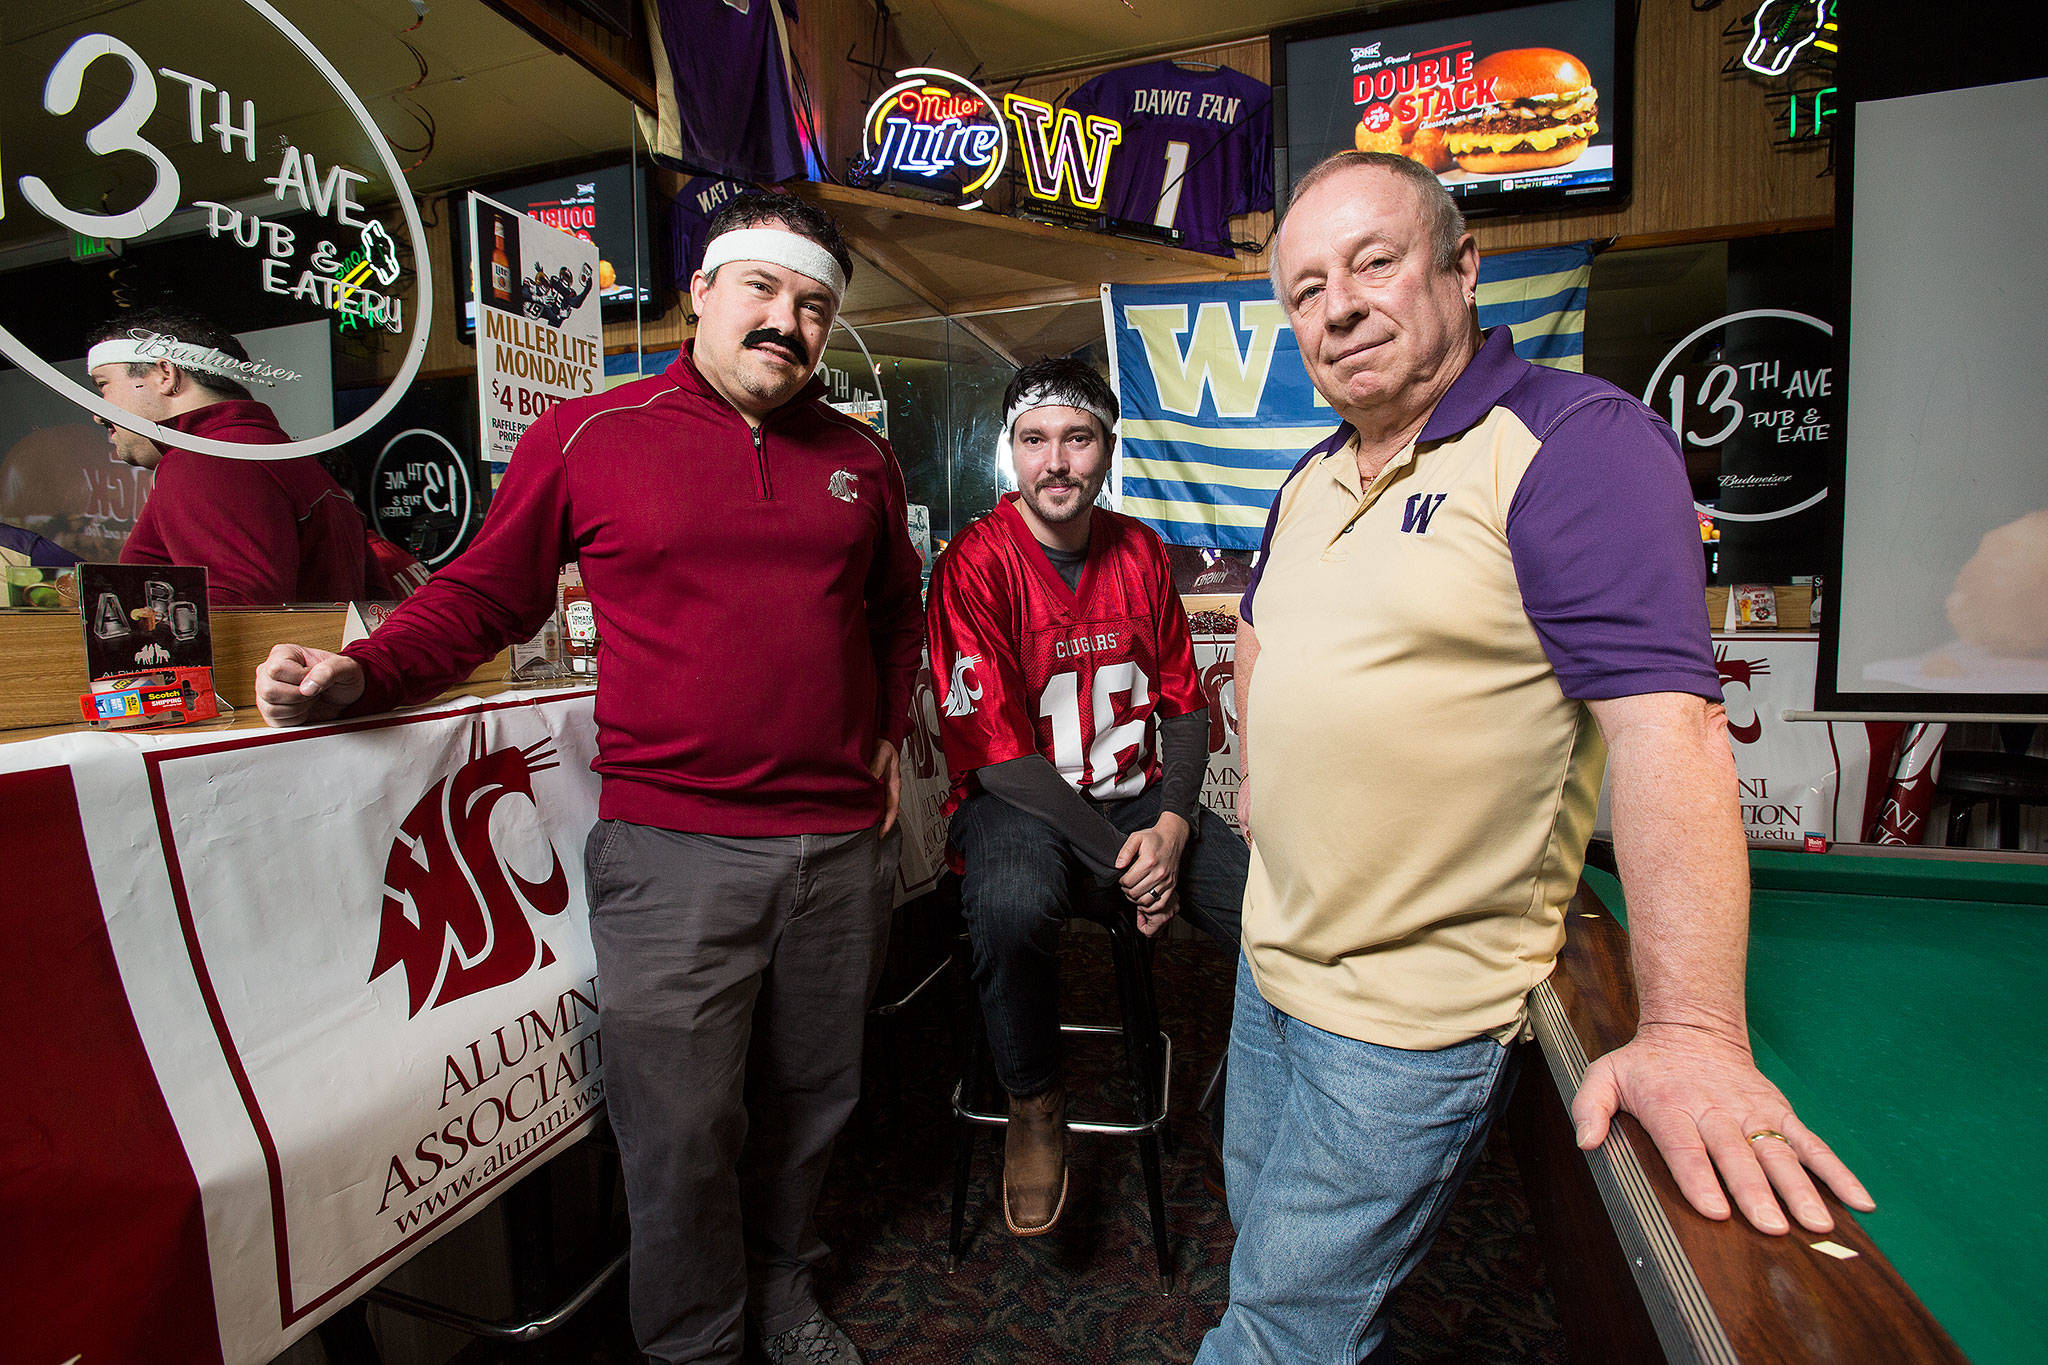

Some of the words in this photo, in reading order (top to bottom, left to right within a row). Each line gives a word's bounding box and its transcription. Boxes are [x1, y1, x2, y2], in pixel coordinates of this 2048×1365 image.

[1353, 61, 1382, 74] Quarter
[1384, 53, 1411, 65] Pound
[1353, 51, 1474, 105] DOUBLE
[900, 92, 985, 122] Miller
[1134, 88, 1192, 116] DAWG
[1197, 94, 1242, 124] FAN
[1399, 77, 1499, 124] STACK
[1468, 109, 1483, 120] and
[1485, 106, 1500, 117] Tots
[0, 33, 257, 239] 3TH
[264, 146, 368, 228] AVE
[873, 117, 1000, 177] Lite
[1004, 93, 1122, 210] W
[1153, 141, 1190, 229] 1
[192, 201, 296, 258] PUB
[311, 241, 344, 273] &
[262, 258, 402, 333] EATERY
[127, 328, 302, 382] Budweiser
[486, 309, 559, 358] MILLER
[562, 333, 598, 368] LITE
[1124, 300, 1293, 418] W
[495, 343, 593, 394] MONDAY'S
[492, 417, 516, 433] RAFFLE
[517, 423, 528, 433] PR
[1669, 360, 1780, 449] 13TH
[1782, 368, 1832, 400] AVE
[1749, 409, 1794, 429] PUB
[1803, 407, 1821, 424] &
[1777, 424, 1831, 443] EATE
[1717, 473, 1793, 488] Budweiser
[1400, 492, 1448, 534] W
[148, 690, 181, 700] Scotch
[151, 697, 182, 707] SHIPPING
[1040, 661, 1151, 800] 16
